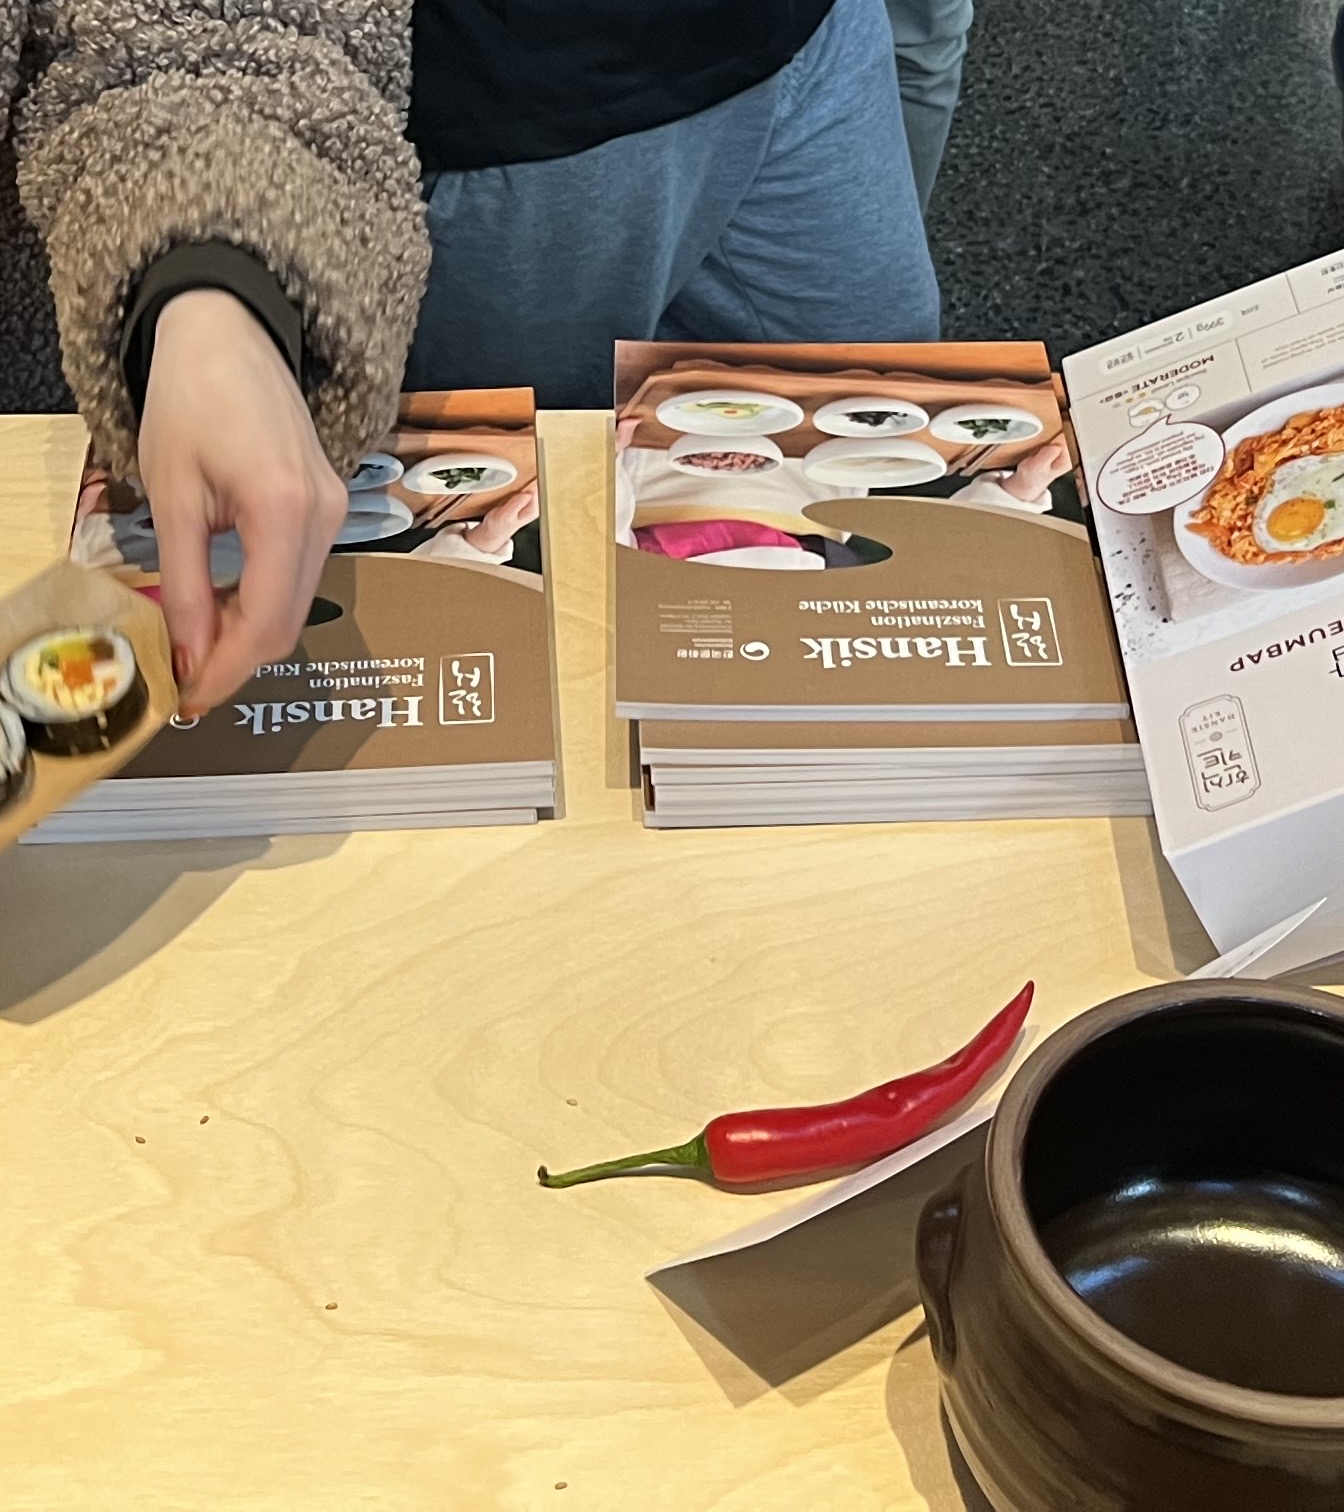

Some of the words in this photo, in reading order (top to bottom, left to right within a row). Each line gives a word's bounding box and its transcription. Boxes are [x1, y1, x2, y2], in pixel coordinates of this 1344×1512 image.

[1131, 354, 1214, 392] MODERATE
[799, 600, 860, 612] Küche
[865, 599, 982, 611] koreanische
[870, 614, 985, 626] Faszination
[800, 636, 991, 667] Hansik
[306, 656, 424, 674] koreanische
[309, 672, 423, 690] Faszination
[233, 695, 424, 735] Hansik
[1190, 713, 1234, 733] HANSIK
[1196, 747, 1242, 770] 키트
[1200, 764, 1249, 793] 한식
